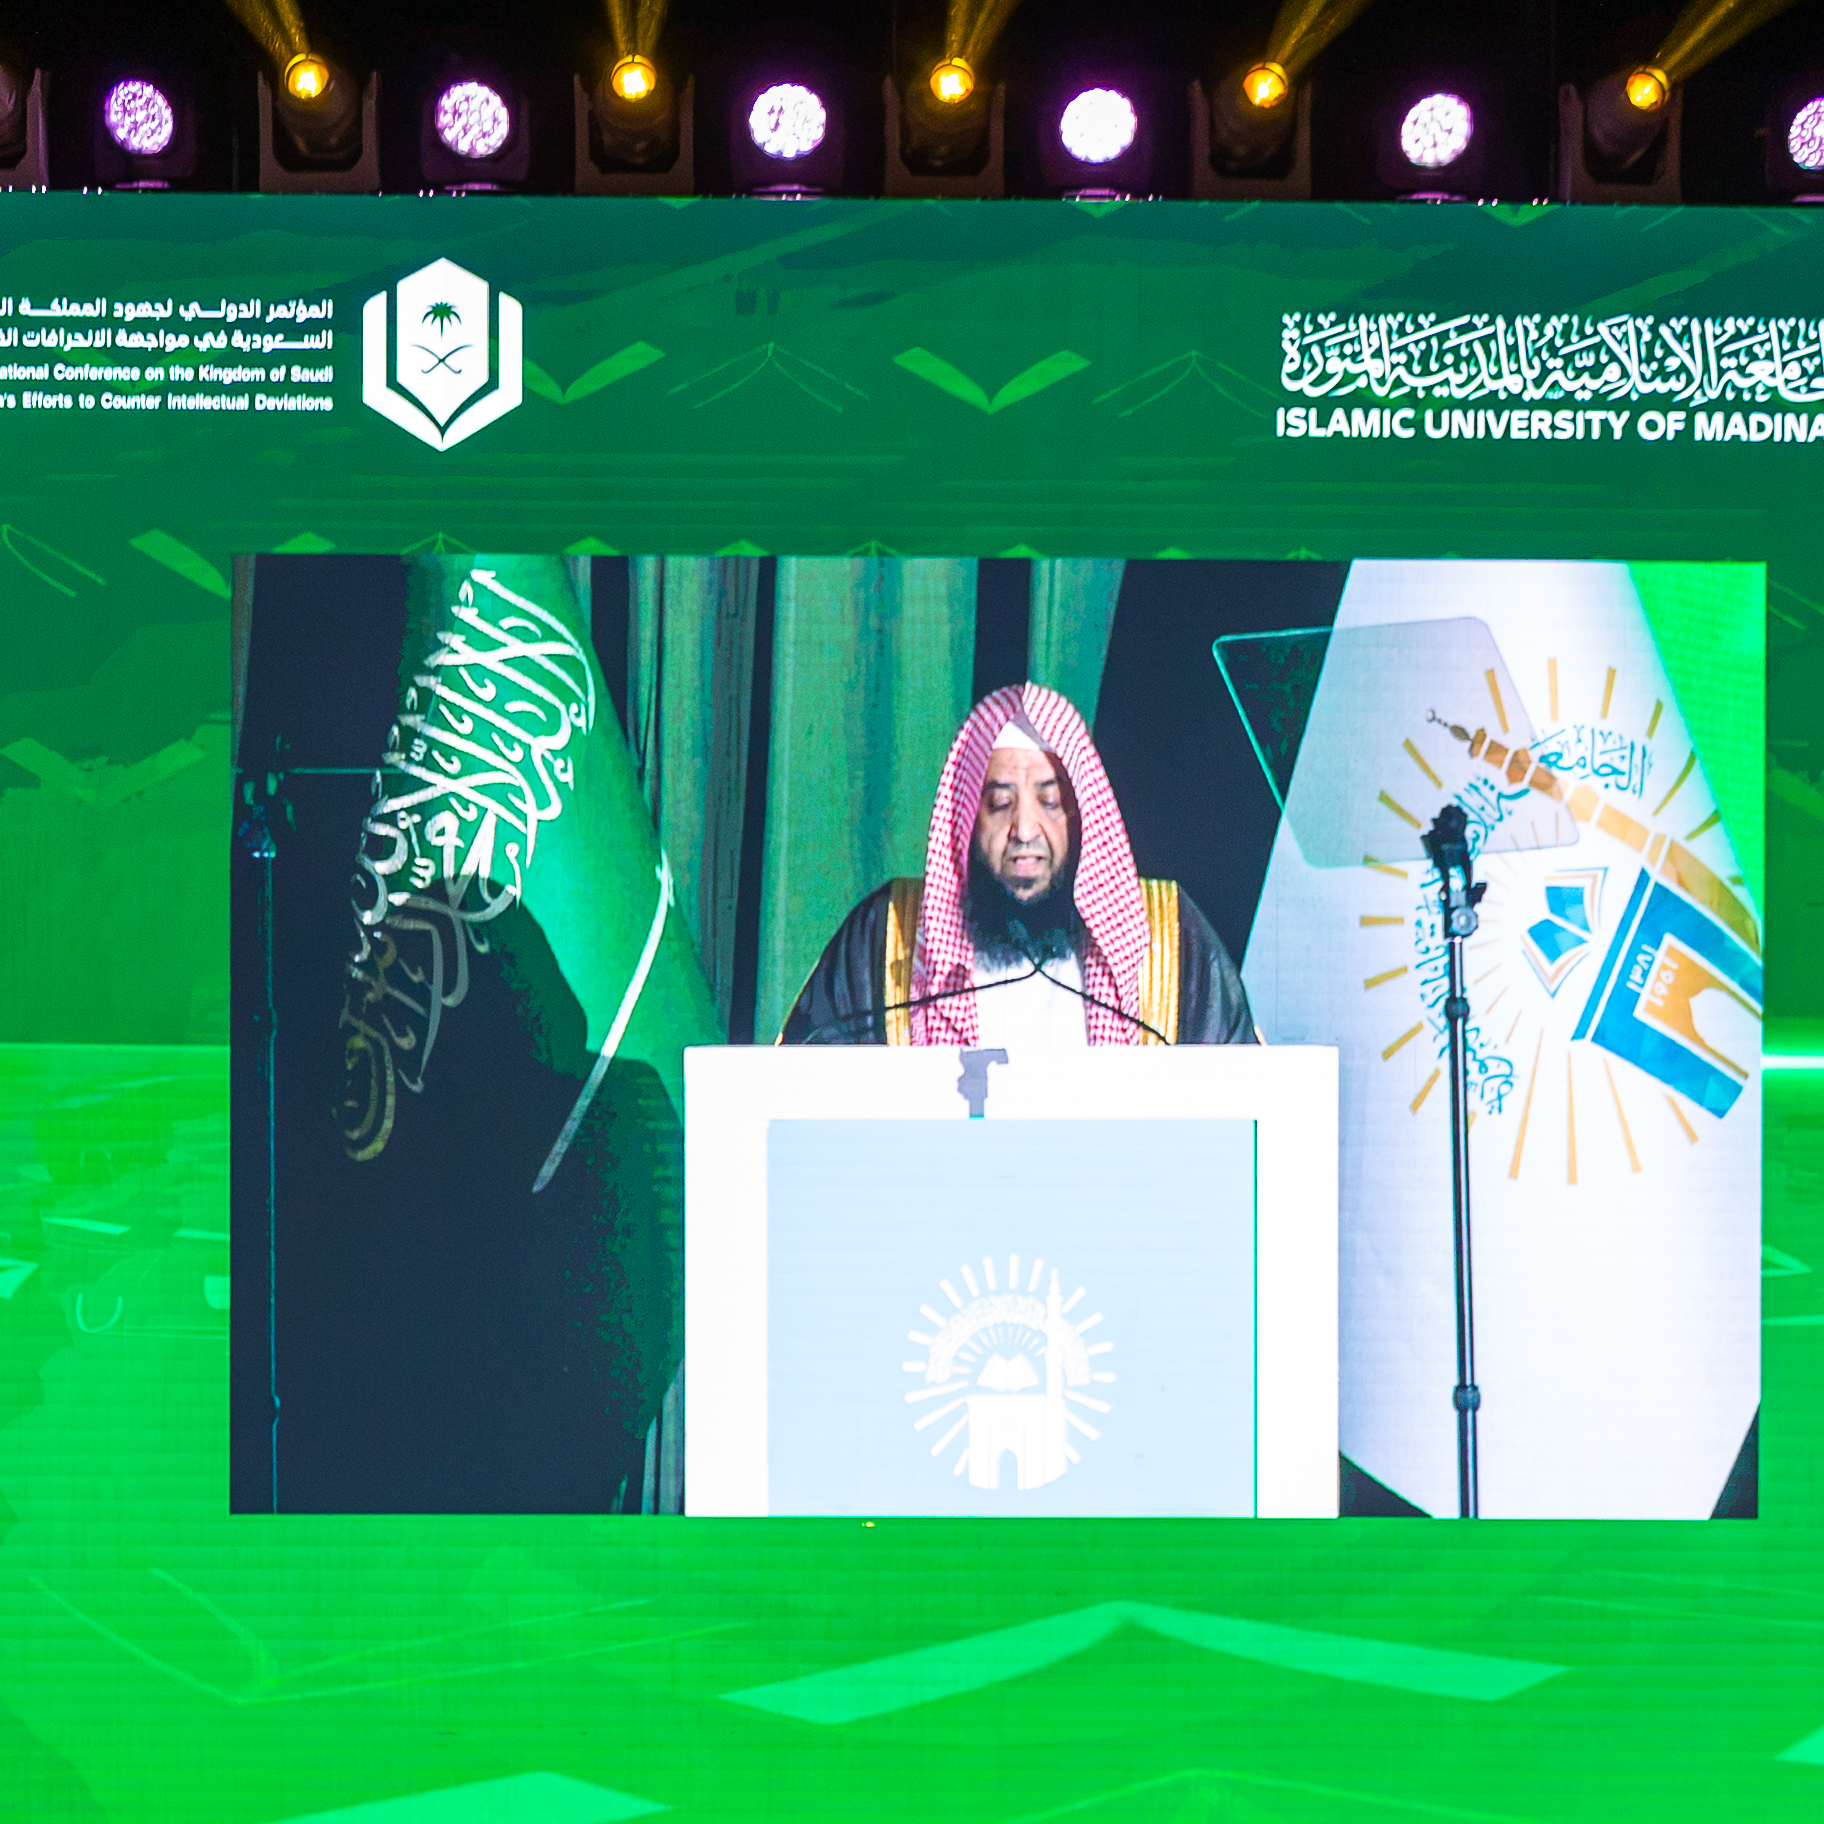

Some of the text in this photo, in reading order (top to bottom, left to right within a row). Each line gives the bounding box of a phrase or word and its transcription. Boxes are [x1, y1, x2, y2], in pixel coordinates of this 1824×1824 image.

[114, 298, 173, 322] لجهود
[266, 298, 334, 323] المؤتمر
[22, 327, 112, 352] الانحرافات
[114, 328, 190, 353] مواجهة
[193, 329, 228, 352] في
[53, 362, 141, 382] Conference
[144, 366, 165, 382] on
[168, 364, 195, 382] the
[198, 364, 266, 385] Kingdom
[269, 365, 287, 382] of
[290, 365, 334, 383] Saudi
[22, 391, 74, 409] Efforts
[78, 393, 96, 409] to
[100, 391, 162, 410] Counter
[167, 391, 250, 411] Intellectual
[254, 393, 334, 411] Deviations
[1276, 407, 1416, 439] ISLAMIC
[1424, 408, 1631, 441] UNIVERSITY
[1637, 410, 1687, 441] OF
